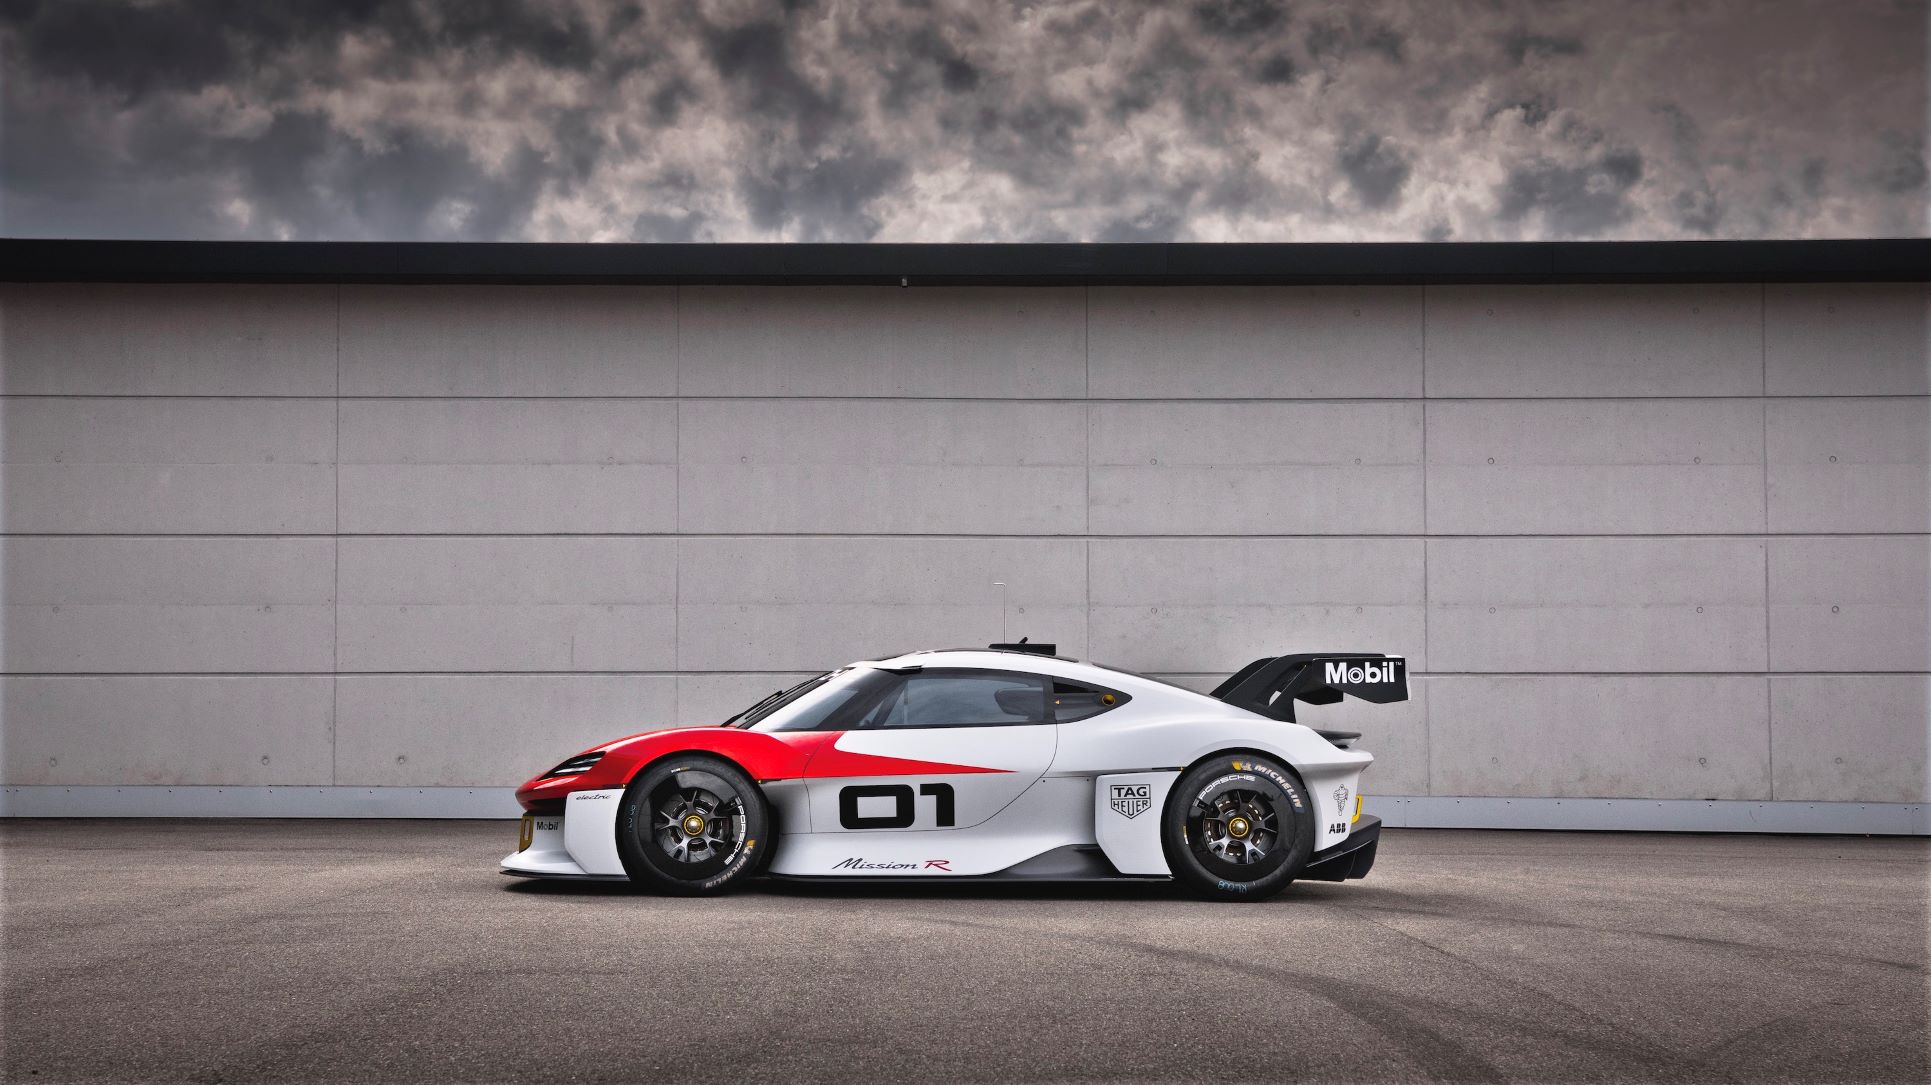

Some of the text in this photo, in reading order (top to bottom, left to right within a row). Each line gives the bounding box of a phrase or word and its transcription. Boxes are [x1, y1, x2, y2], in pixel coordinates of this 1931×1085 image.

[1325, 661, 1395, 684] Mobil
[1113, 786, 1147, 798] TAG
[1198, 774, 1256, 800] PORSCHE
[1254, 764, 1303, 808] MICHELIN
[838, 782, 955, 829] 01
[1113, 799, 1148, 816] HEUER
[536, 821, 558, 831] Mobil
[724, 805, 746, 865] PORSCHE
[1328, 822, 1346, 834] ABB
[705, 855, 747, 888] MICHELIN
[831, 857, 952, 872] Mission R
